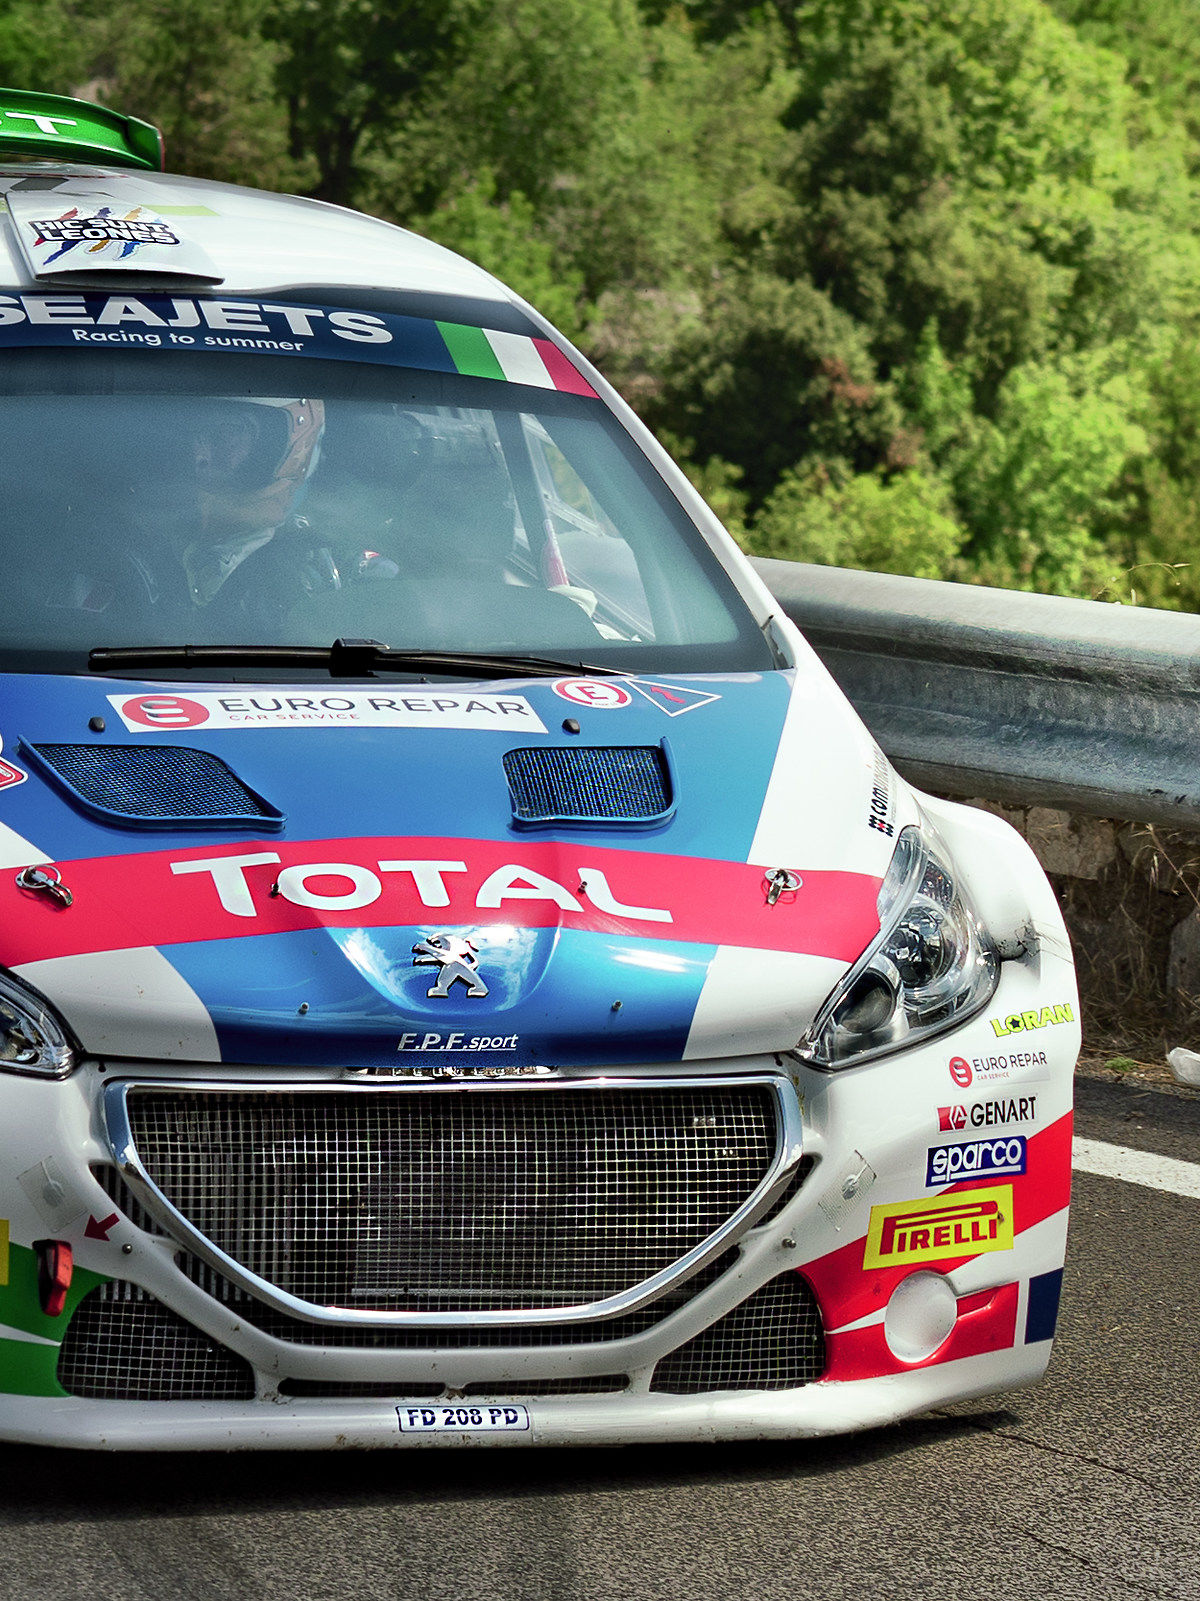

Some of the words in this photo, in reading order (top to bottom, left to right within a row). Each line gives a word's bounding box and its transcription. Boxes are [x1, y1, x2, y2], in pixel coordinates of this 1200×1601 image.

[37, 219, 87, 232] HIC
[89, 217, 167, 233] SUNT
[40, 228, 178, 245] LEONES
[72, 328, 162, 347] Racing
[169, 332, 194, 346] to
[205, 336, 303, 352] summer
[218, 697, 356, 713] EURO
[367, 698, 530, 716] REPAR
[276, 713, 361, 721] SERVICE
[170, 852, 673, 924] TOTAL
[990, 1003, 1075, 1038] LORAN
[972, 1055, 1008, 1072] EURO
[1010, 1052, 1048, 1069] REPAR
[970, 1096, 1036, 1127] GENART
[932, 1138, 1022, 1182] sparco
[879, 1200, 998, 1256] PIRELLI
[406, 1408, 436, 1427] FD
[442, 1408, 483, 1426] 208
[489, 1408, 518, 1426] PD
